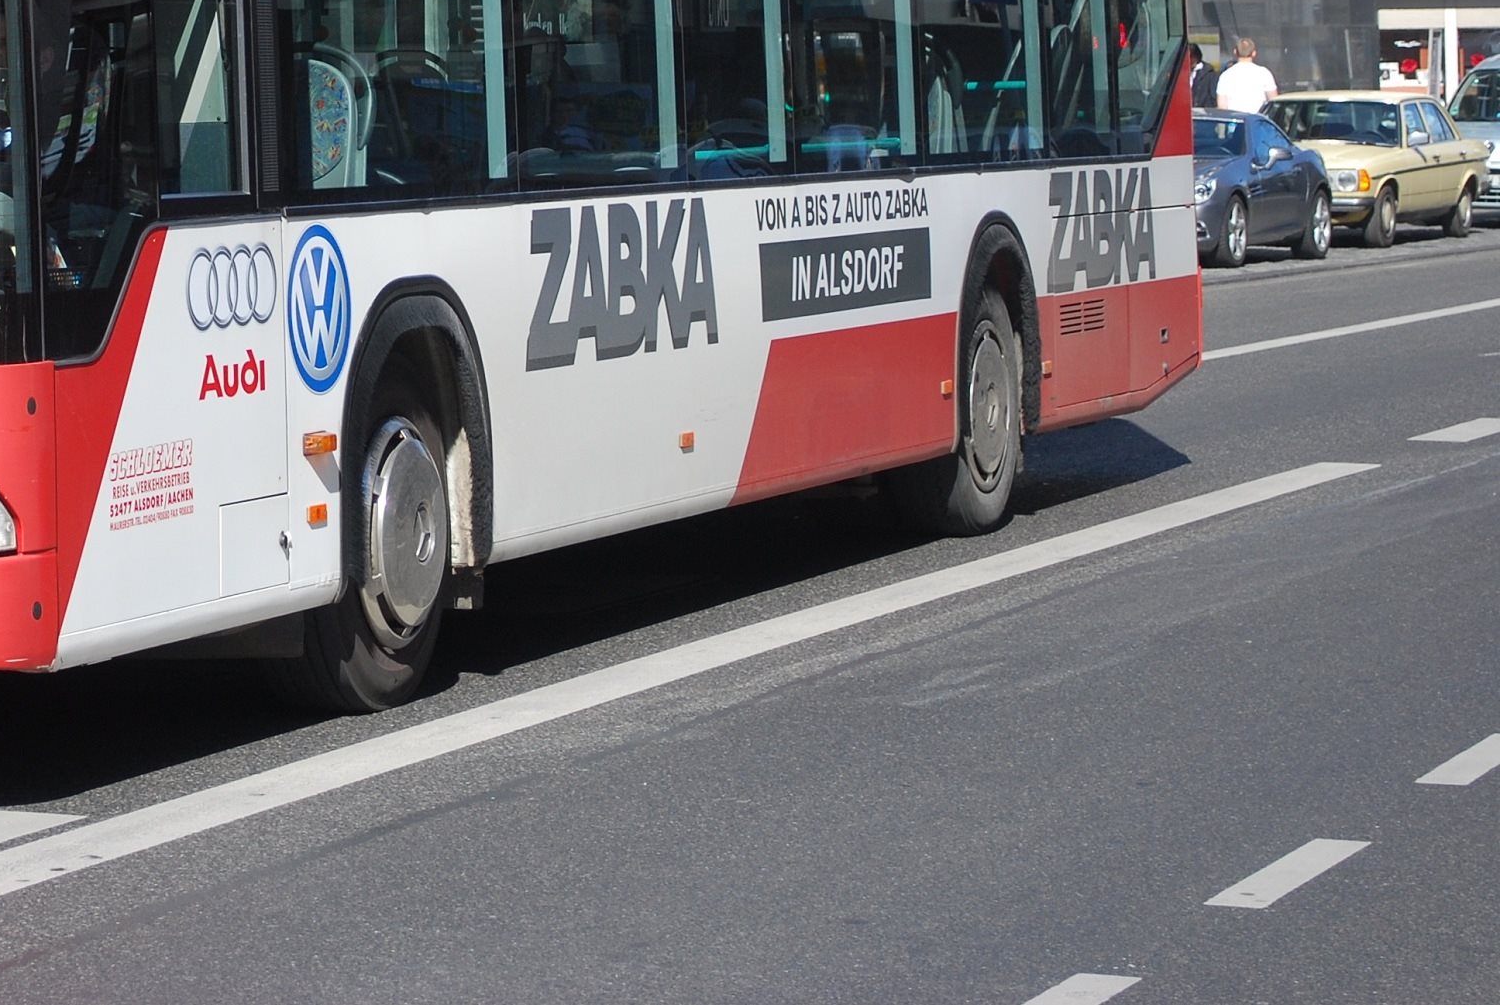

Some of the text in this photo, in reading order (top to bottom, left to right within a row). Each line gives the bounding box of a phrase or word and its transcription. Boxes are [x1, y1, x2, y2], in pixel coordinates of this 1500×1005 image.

[755, 188, 929, 231] VON A BIS Z AUTO ZABKA
[1047, 167, 1156, 293] ZABKA
[526, 197, 719, 372] ZABKA
[792, 245, 904, 302] IN ALSDORF
[199, 349, 266, 401] Audi
[110, 438, 193, 482] SCHLOEMER
[110, 501, 132, 517] 52477
[113, 484, 129, 499] REISE
